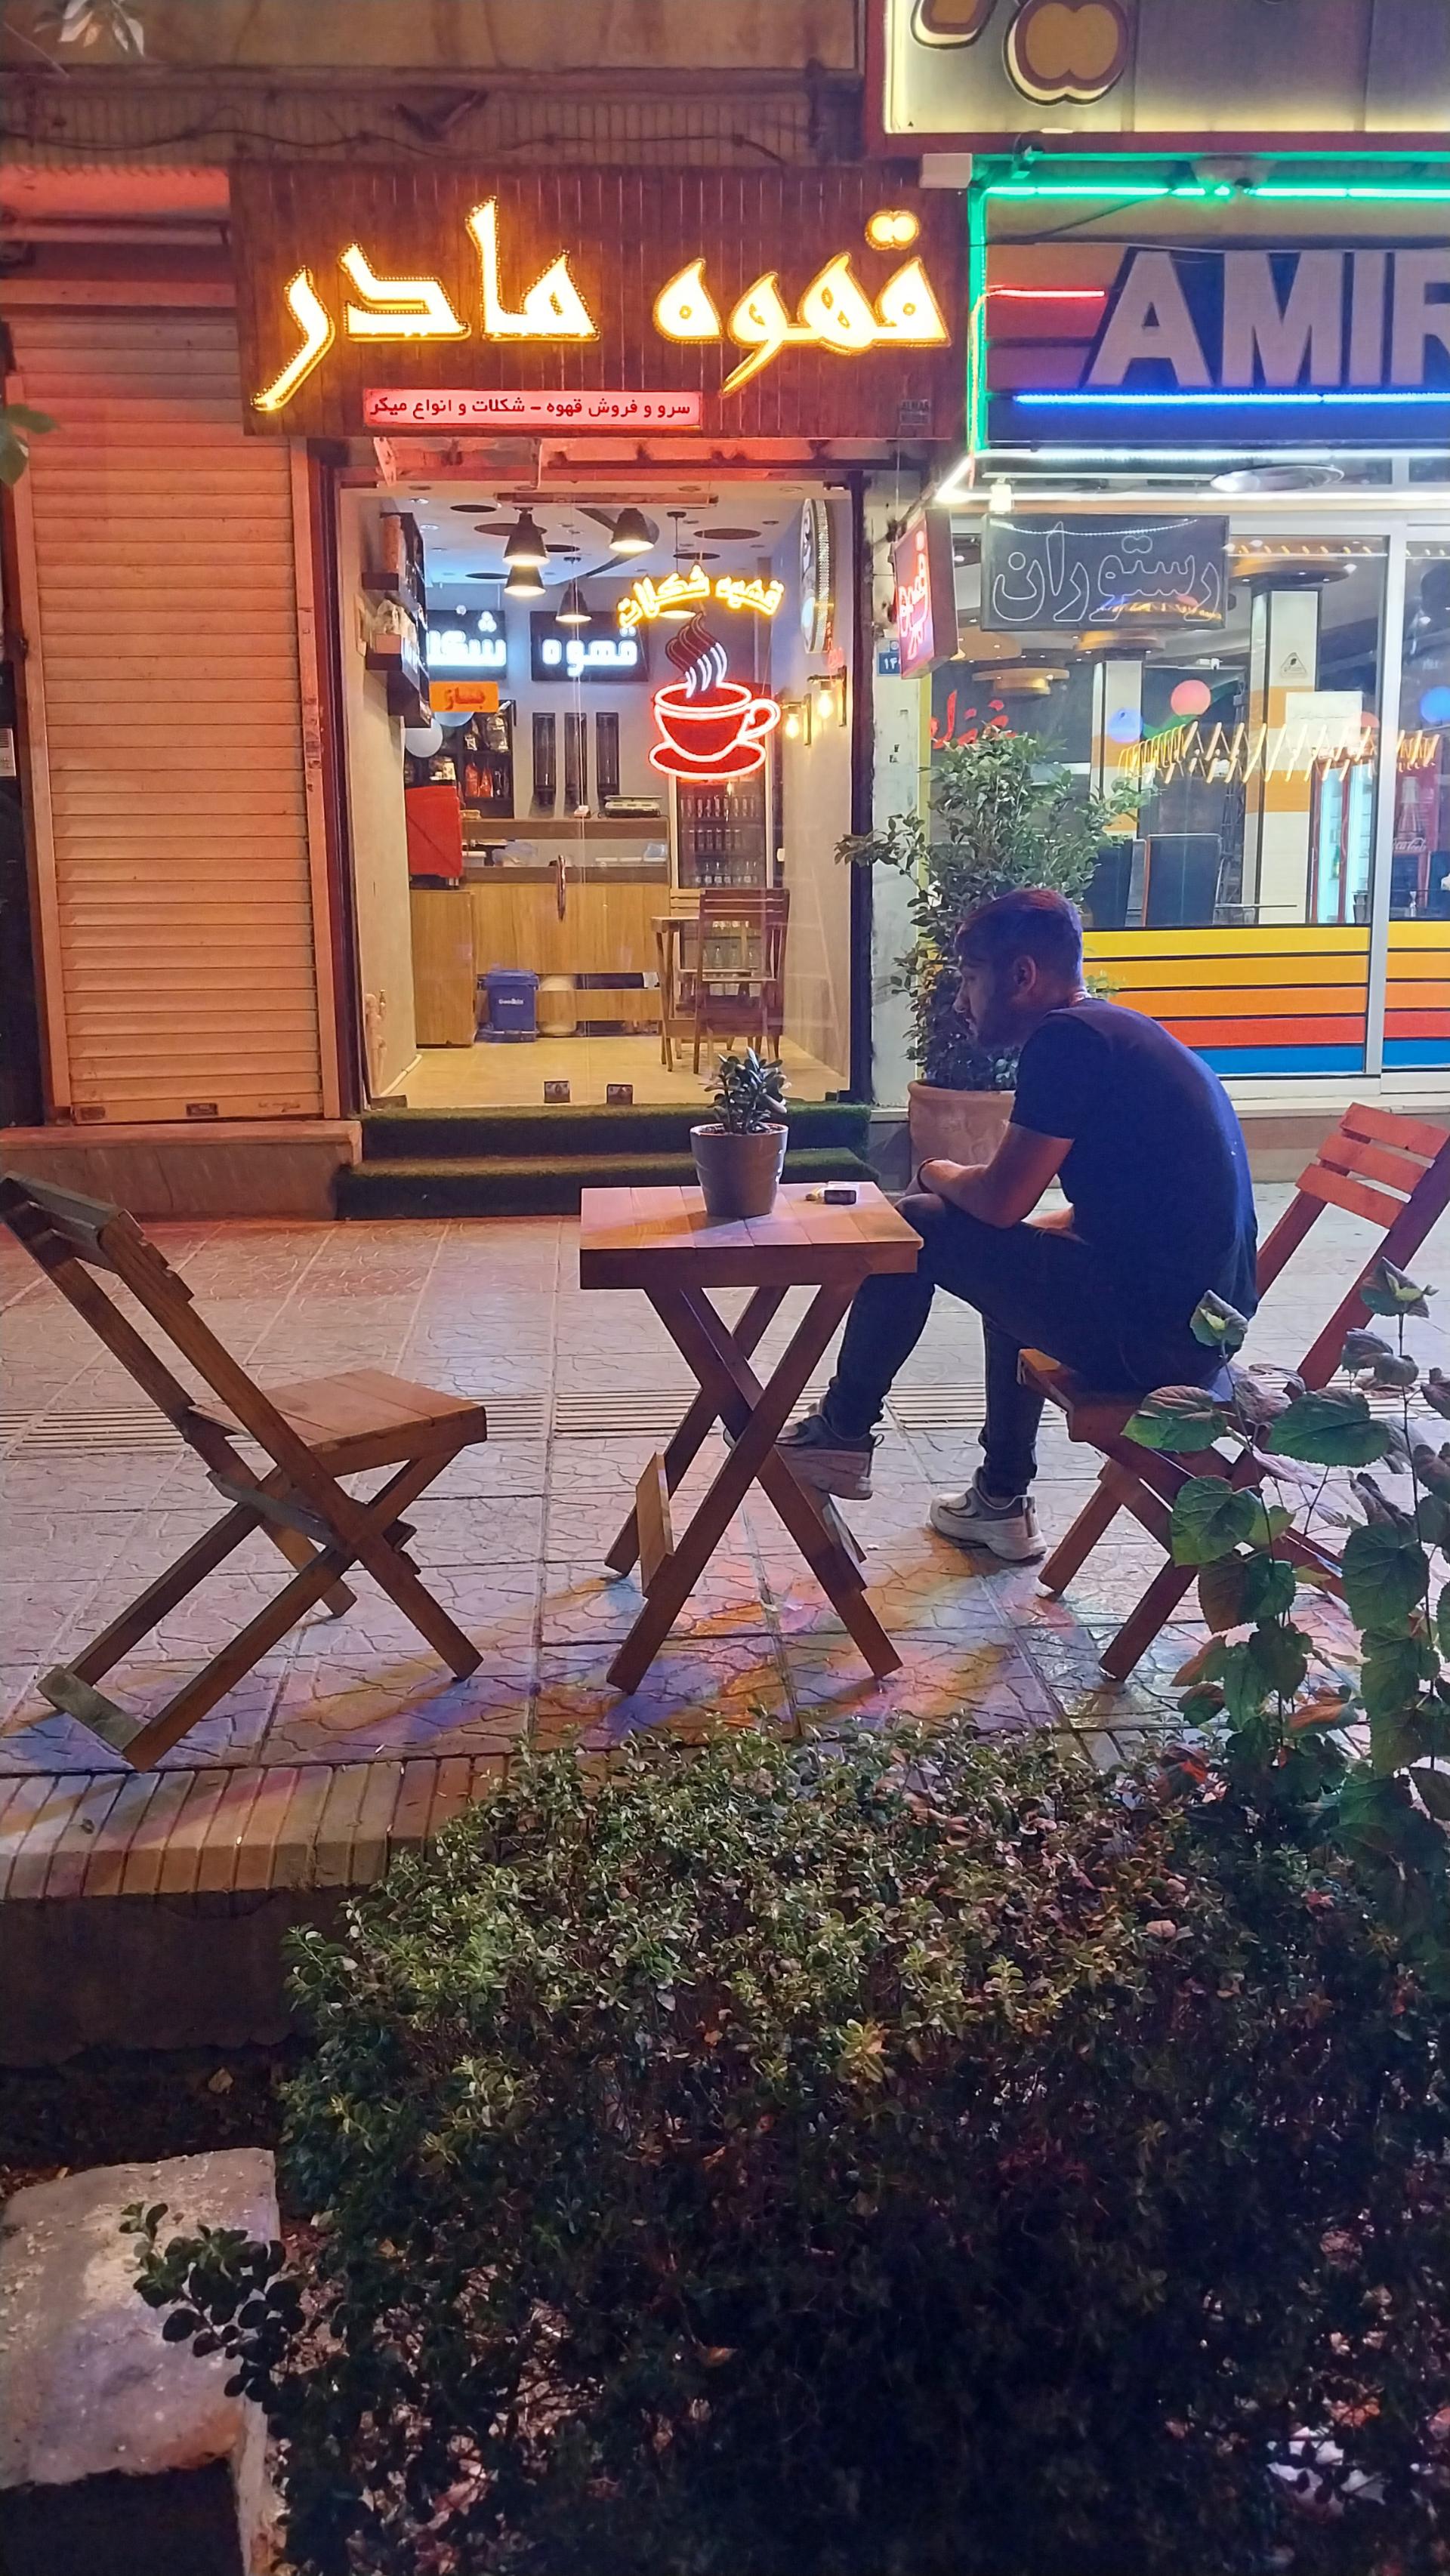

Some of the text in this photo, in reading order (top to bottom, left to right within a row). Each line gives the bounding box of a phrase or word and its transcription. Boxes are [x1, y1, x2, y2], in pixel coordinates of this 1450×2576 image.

[251, 195, 951, 411] قهوه مادر
[1084, 250, 1450, 387] AMIR
[413, 399, 452, 420] انواع
[458, 403, 467, 416] و
[472, 397, 525, 412] شکلات
[547, 399, 582, 417] قهوه
[589, 398, 638, 418] فروش
[643, 405, 652, 418] و
[657, 404, 690, 418] سرو
[993, 521, 1220, 621] رستوران
[617, 564, 785, 628] قهوه شکلات
[541, 626, 638, 678] قهوه
